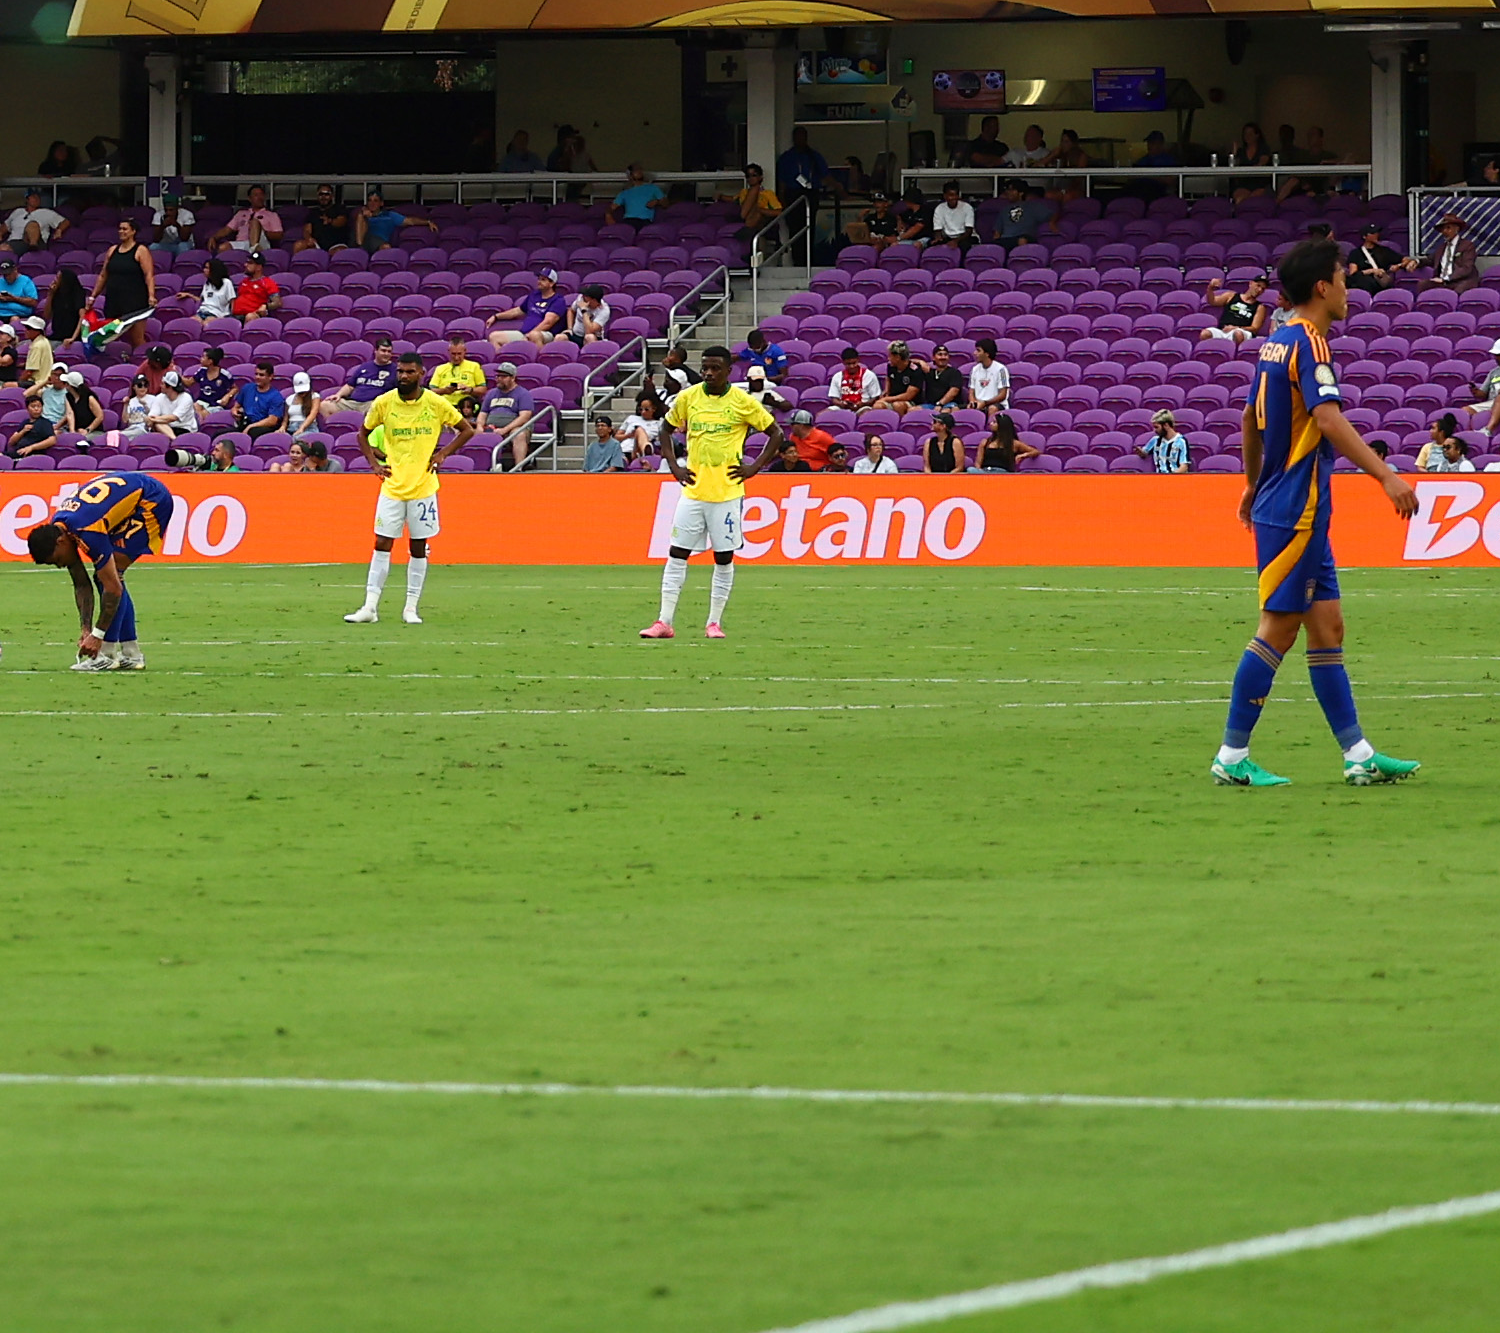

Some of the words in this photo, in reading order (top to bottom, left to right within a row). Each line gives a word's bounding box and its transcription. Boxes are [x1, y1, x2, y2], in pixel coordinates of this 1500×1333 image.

[160, 178, 169, 195] 2
[417, 501, 437, 521] 24
[724, 512, 735, 534] 4
